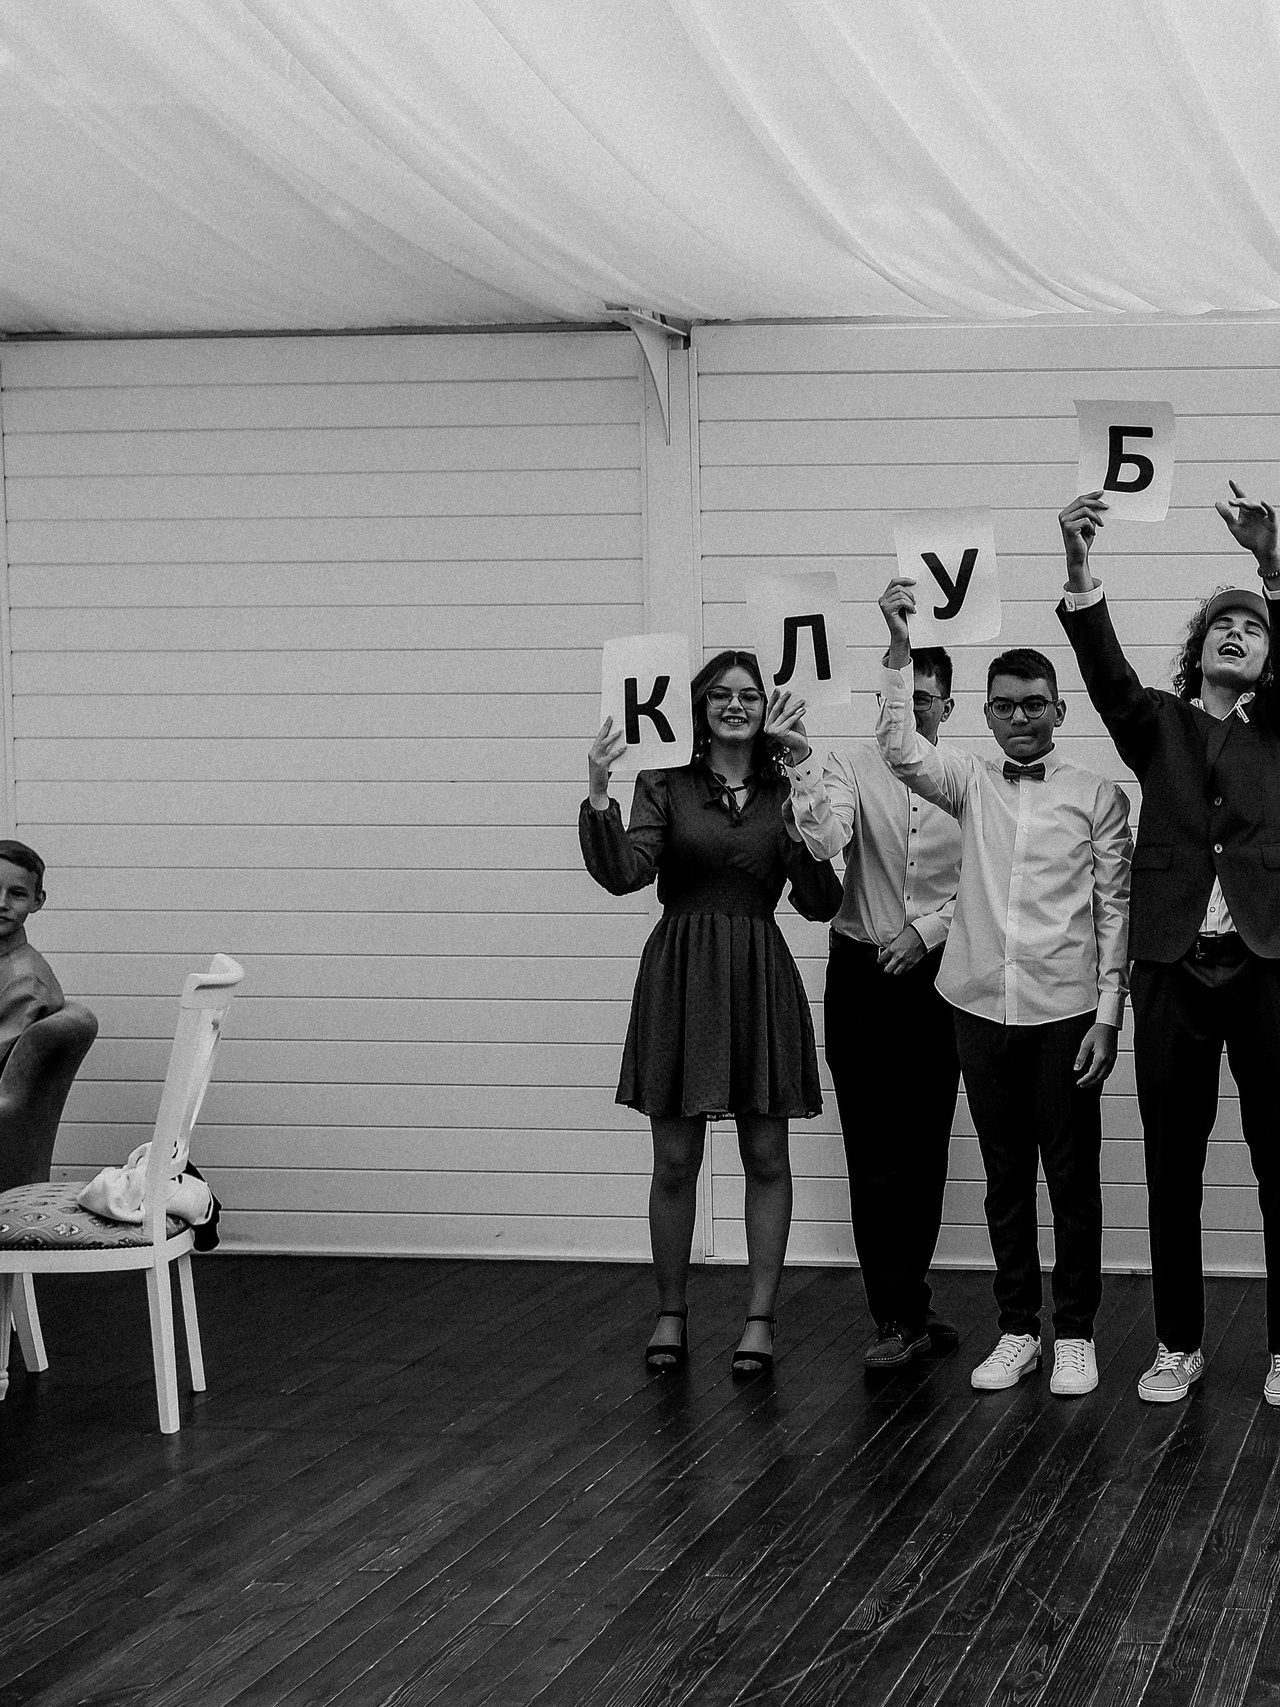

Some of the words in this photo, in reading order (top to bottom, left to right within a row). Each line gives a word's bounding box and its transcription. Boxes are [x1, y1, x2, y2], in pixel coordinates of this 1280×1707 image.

[1103, 425, 1155, 493] Б
[920, 548, 979, 620] У
[773, 613, 832, 686] Л
[624, 675, 676, 744] К
